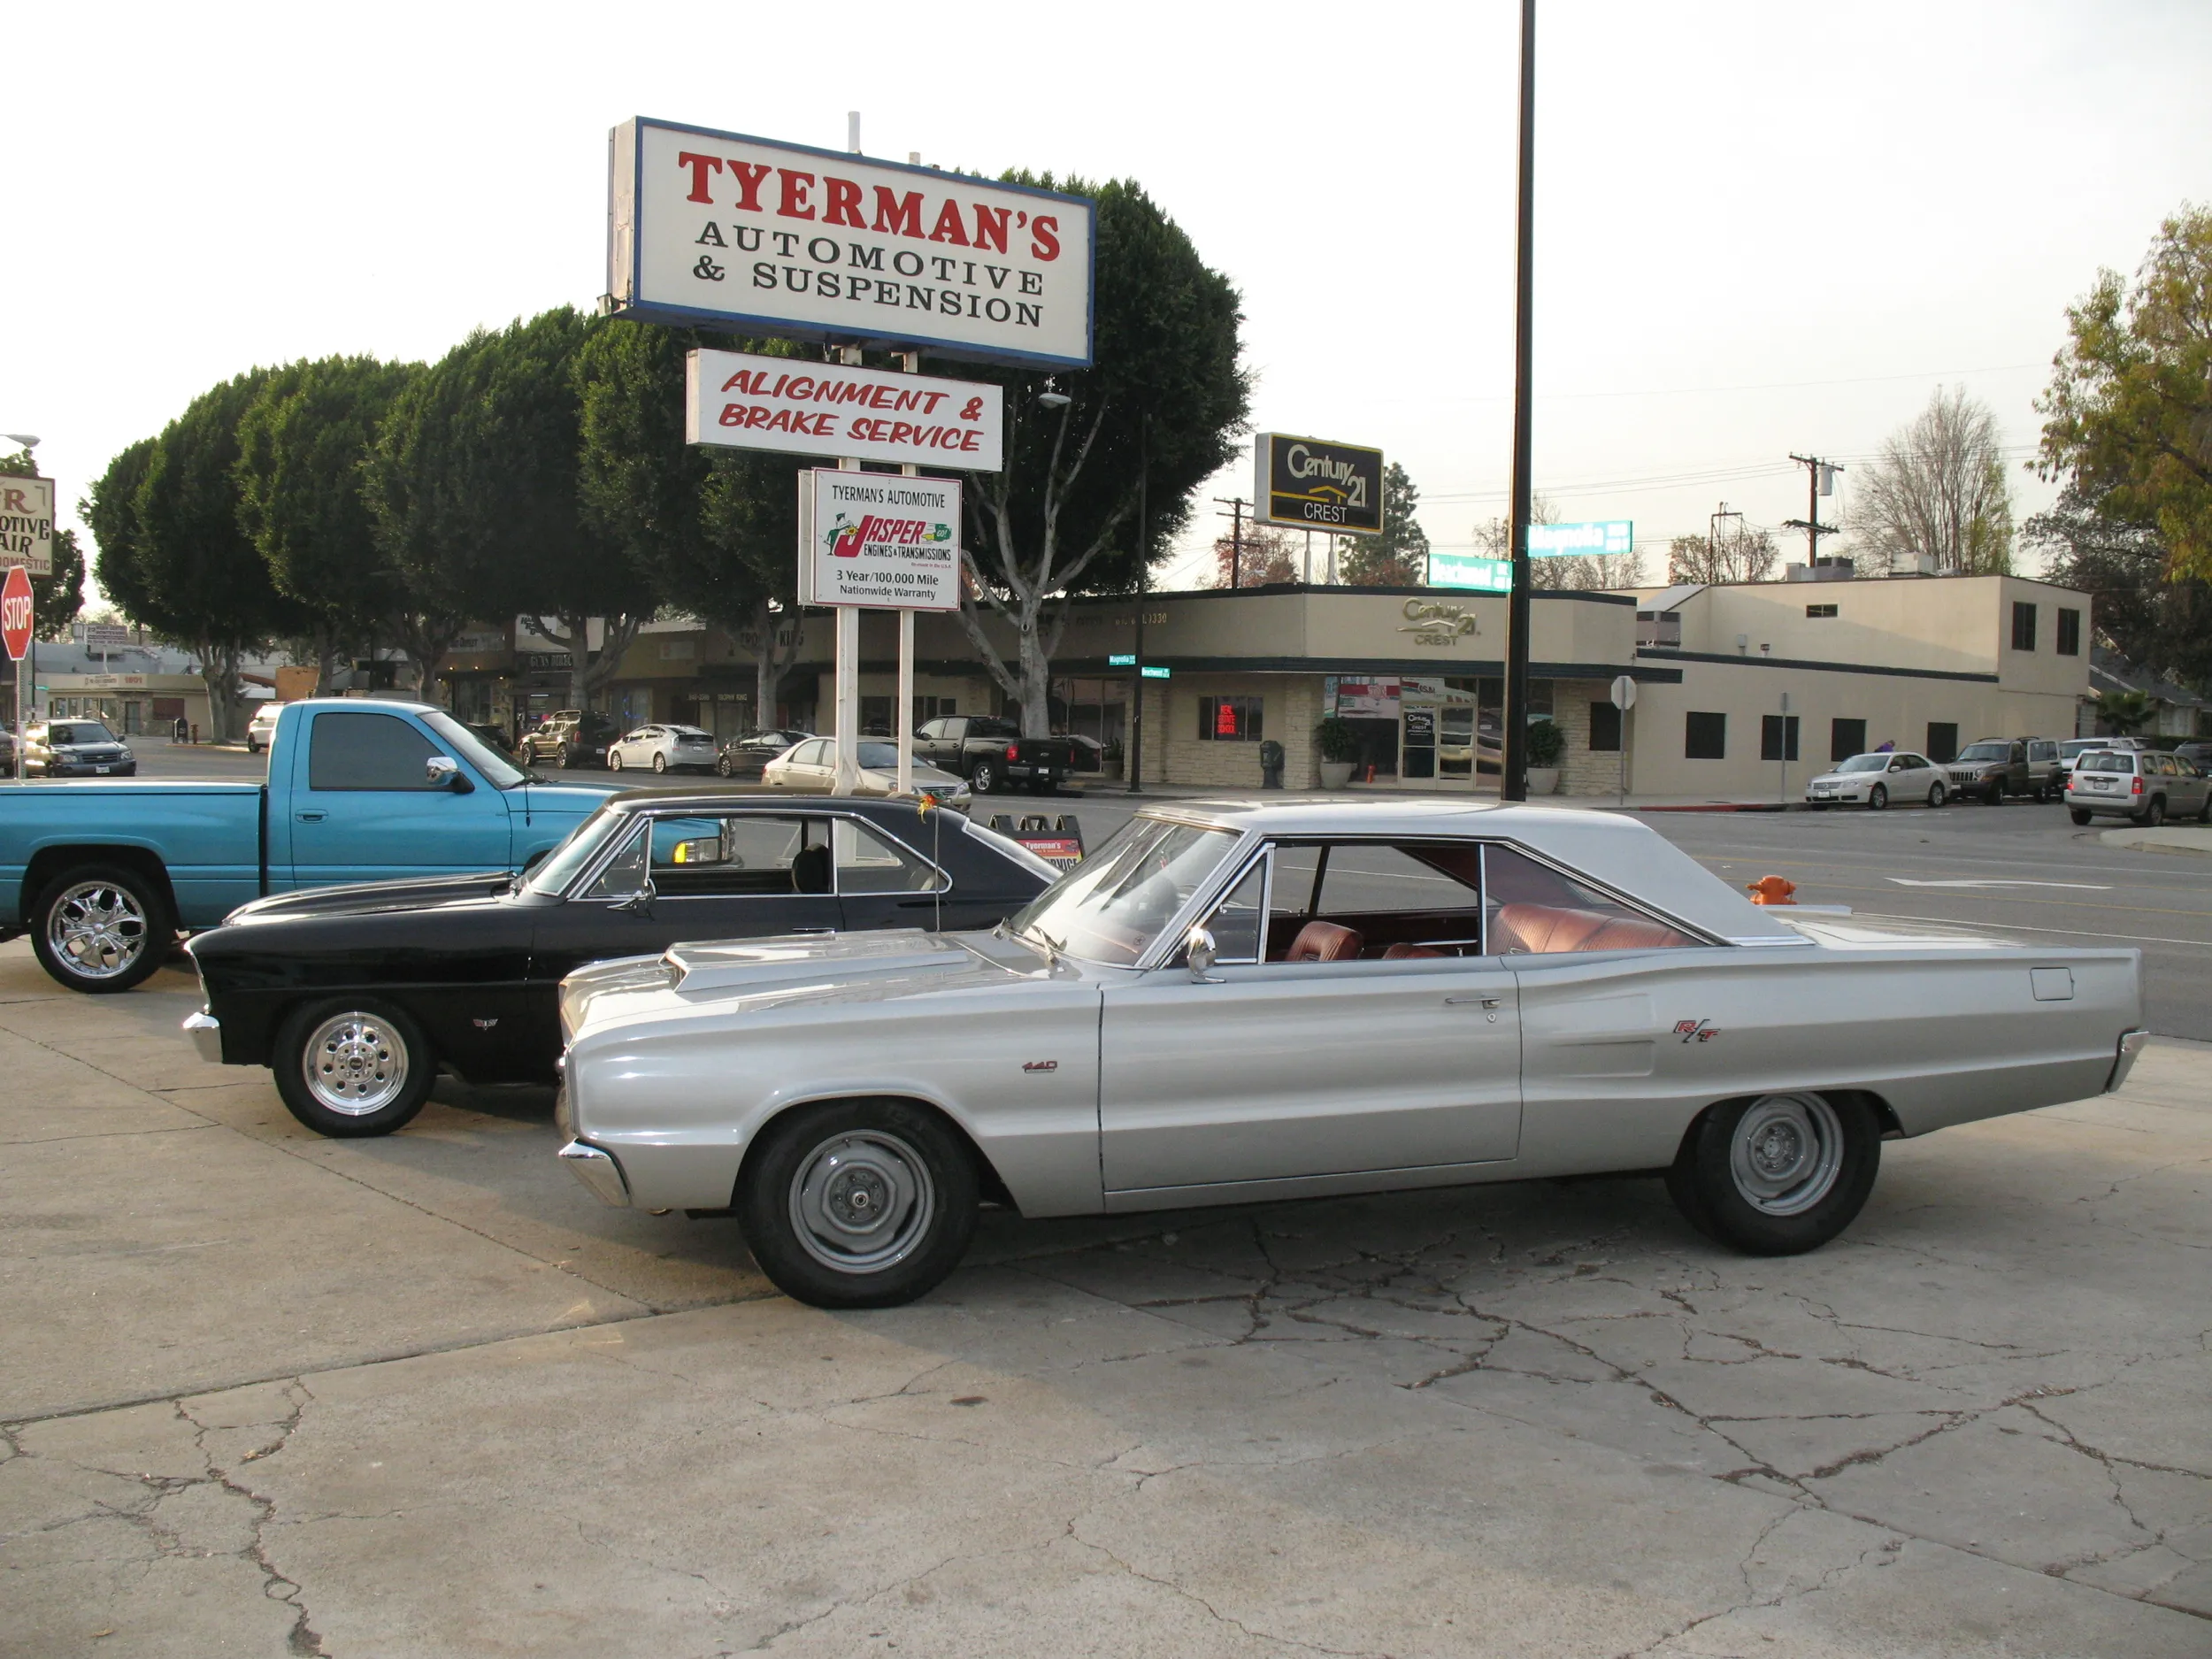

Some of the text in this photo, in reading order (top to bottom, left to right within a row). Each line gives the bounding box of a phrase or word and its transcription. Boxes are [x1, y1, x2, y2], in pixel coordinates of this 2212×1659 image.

[679, 151, 1061, 262] TYERMAN'S
[695, 221, 1043, 296] AUTOMOTIVE
[693, 255, 1043, 327] & SUSPENSION
[720, 369, 984, 421] ALIGNMENT &
[718, 403, 985, 451] BRAKE SERVICE
[833, 485, 945, 508] TYERMAN'S AUTOMOTIVE
[1347, 475, 1366, 507] 21
[1304, 502, 1348, 523] CREST
[833, 515, 926, 557] JASPER
[0, 557, 50, 571] OMESTIC
[864, 543, 893, 557] ENGINES
[898, 546, 951, 561] TRANSMISSIONS
[836, 570, 939, 585] 3 Year/100,000 Mile
[840, 585, 936, 601] Nationwide Warranty
[4, 596, 31, 631] STOP
[1415, 634, 1459, 646] CREST
[1025, 841, 1062, 850] Tyerman's
[1672, 1018, 1721, 1043] R/T
